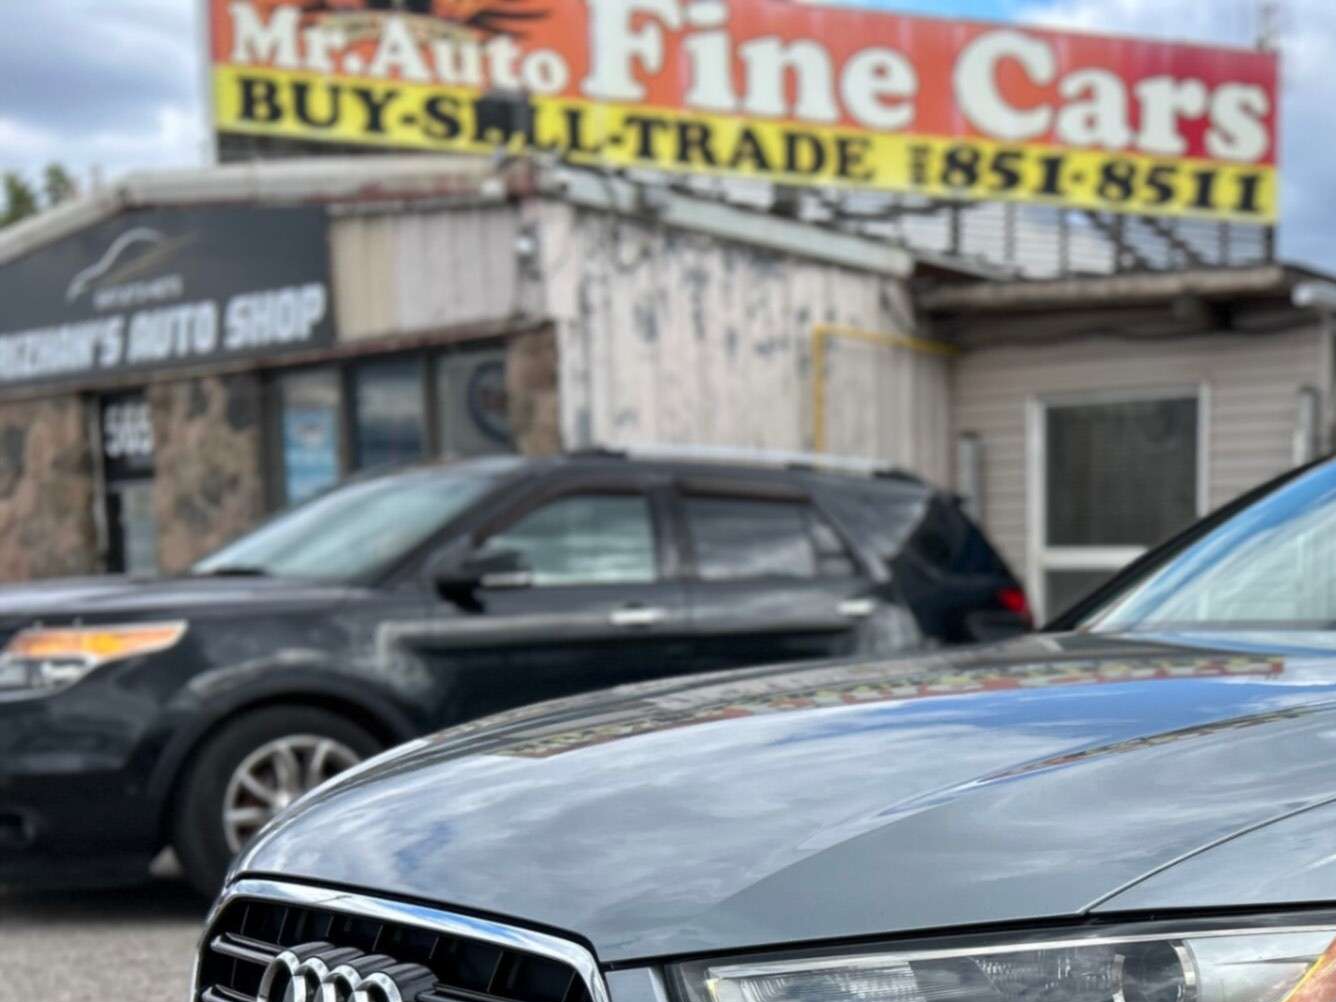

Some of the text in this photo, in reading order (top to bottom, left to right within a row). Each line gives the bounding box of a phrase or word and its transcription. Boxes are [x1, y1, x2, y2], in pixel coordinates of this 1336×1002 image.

[583, 0, 918, 129] Fine
[953, 30, 1272, 162] Cars
[127, 300, 217, 363] AUTO
[223, 282, 326, 350] SHOP
